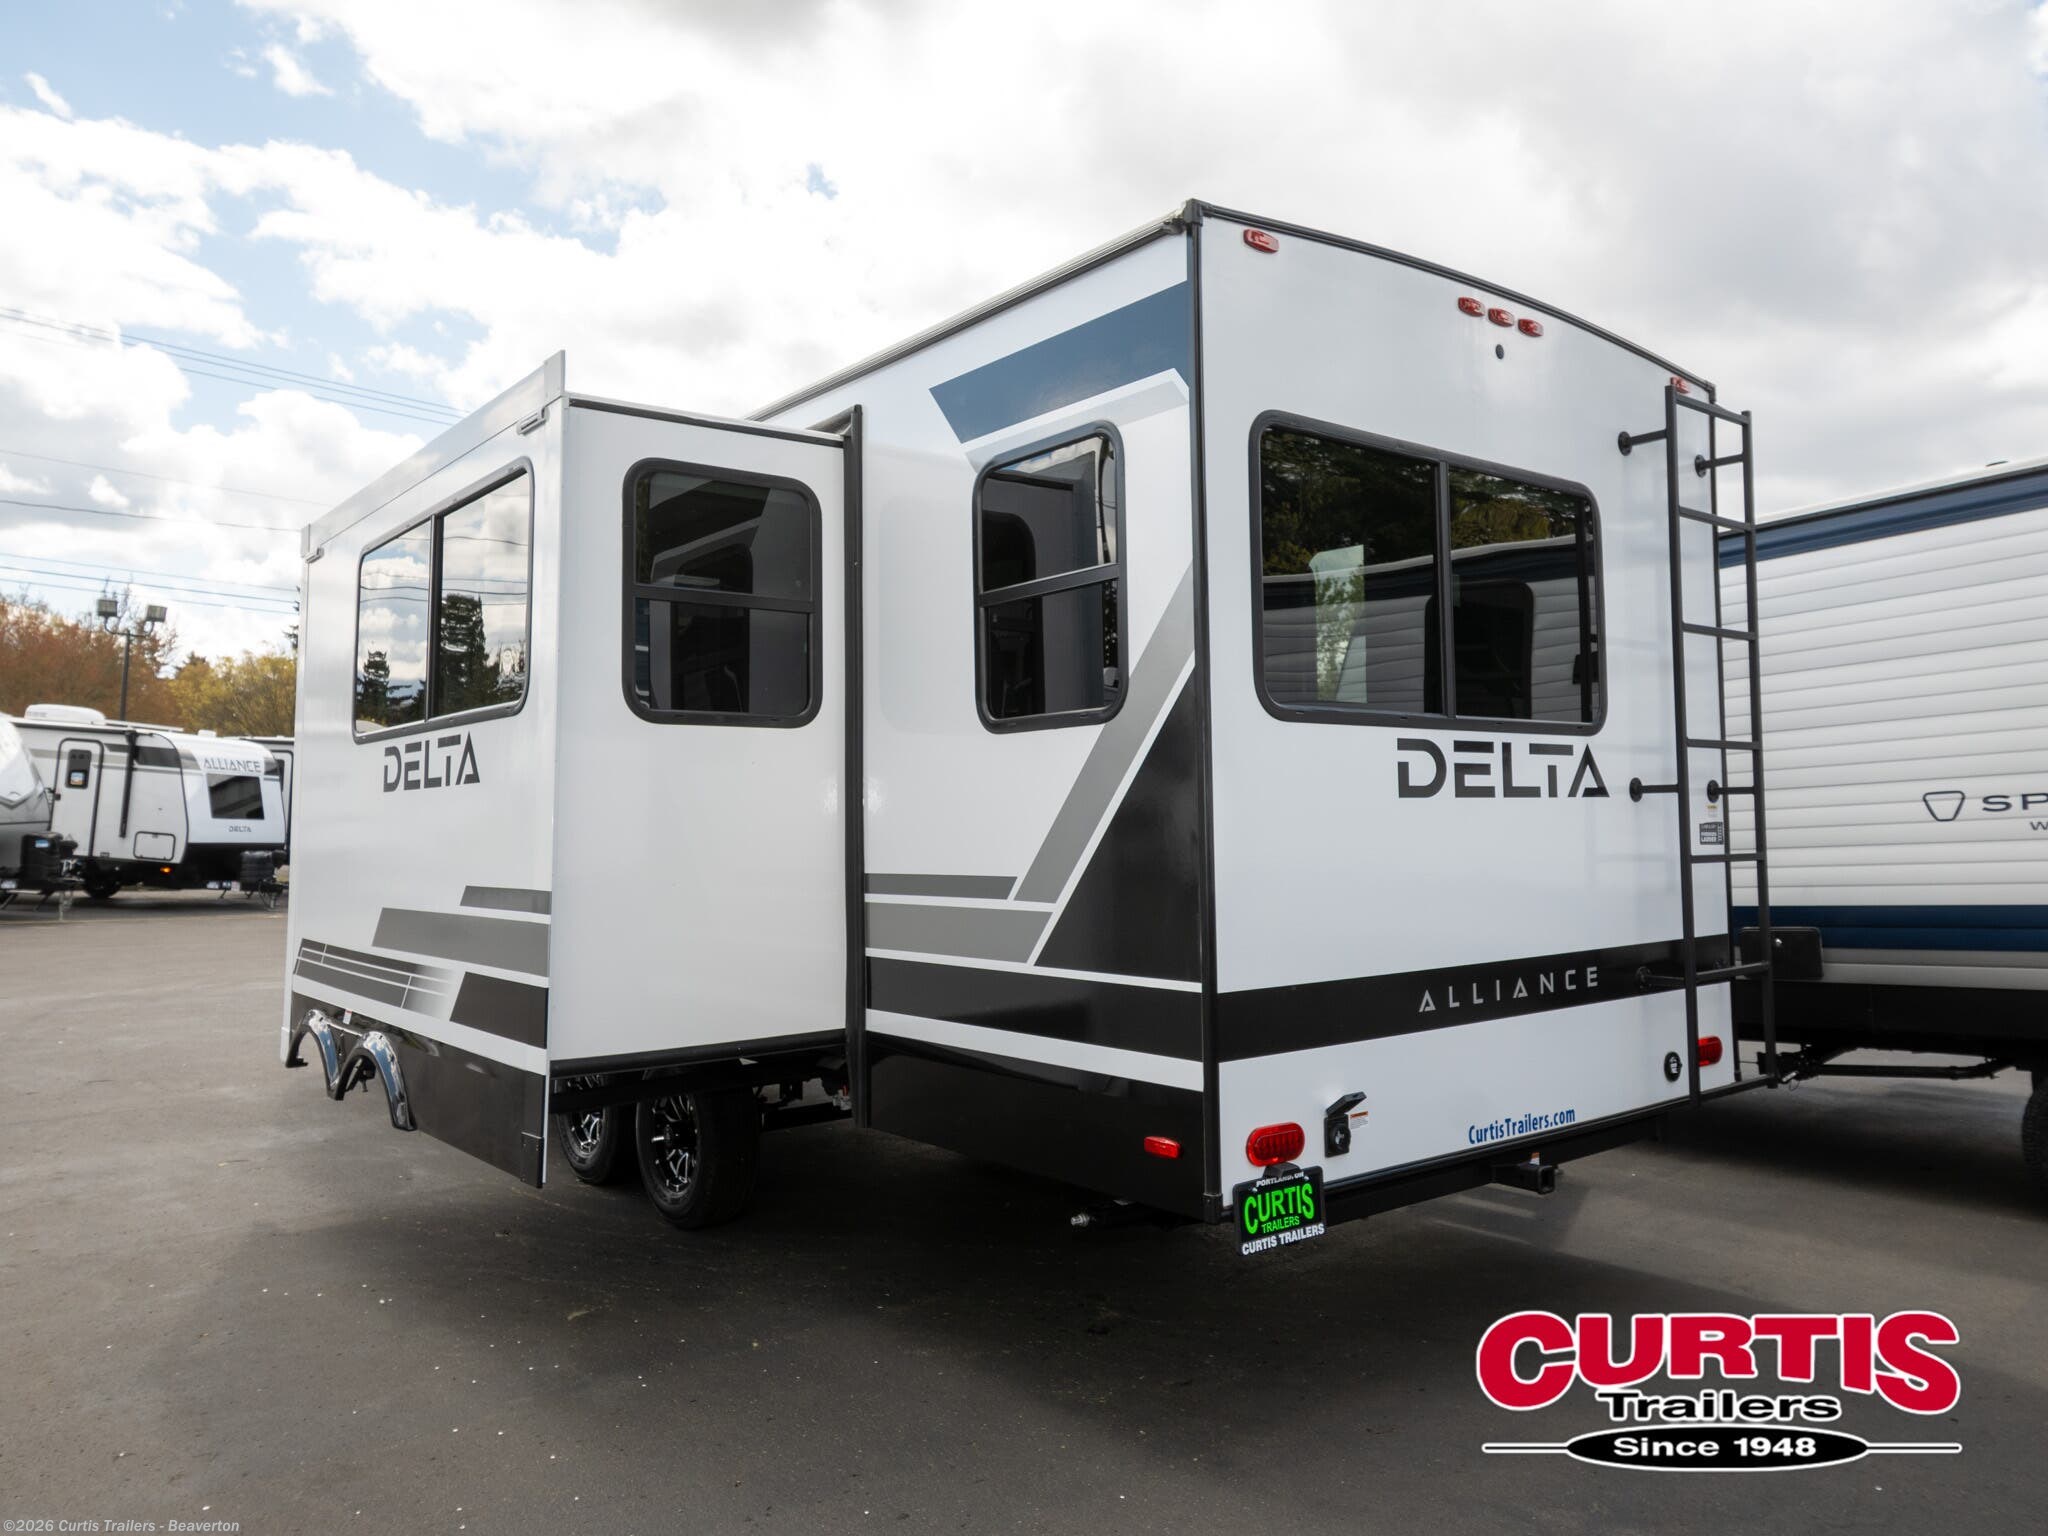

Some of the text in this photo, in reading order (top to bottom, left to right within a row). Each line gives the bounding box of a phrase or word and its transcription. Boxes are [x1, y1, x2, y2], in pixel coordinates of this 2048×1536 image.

[203, 757, 262, 773] ALLIANCE
[383, 731, 481, 793] DELTA
[1398, 738, 1610, 798] DELTA
[1418, 966, 1599, 1012] ALLIANCE
[1468, 1107, 1576, 1146] CurtisTrailers.com
[1244, 1182, 1315, 1234] CURTIS
[1261, 1215, 1300, 1234] TRAILERS
[1241, 1223, 1325, 1256] CURTIS TRAILERS
